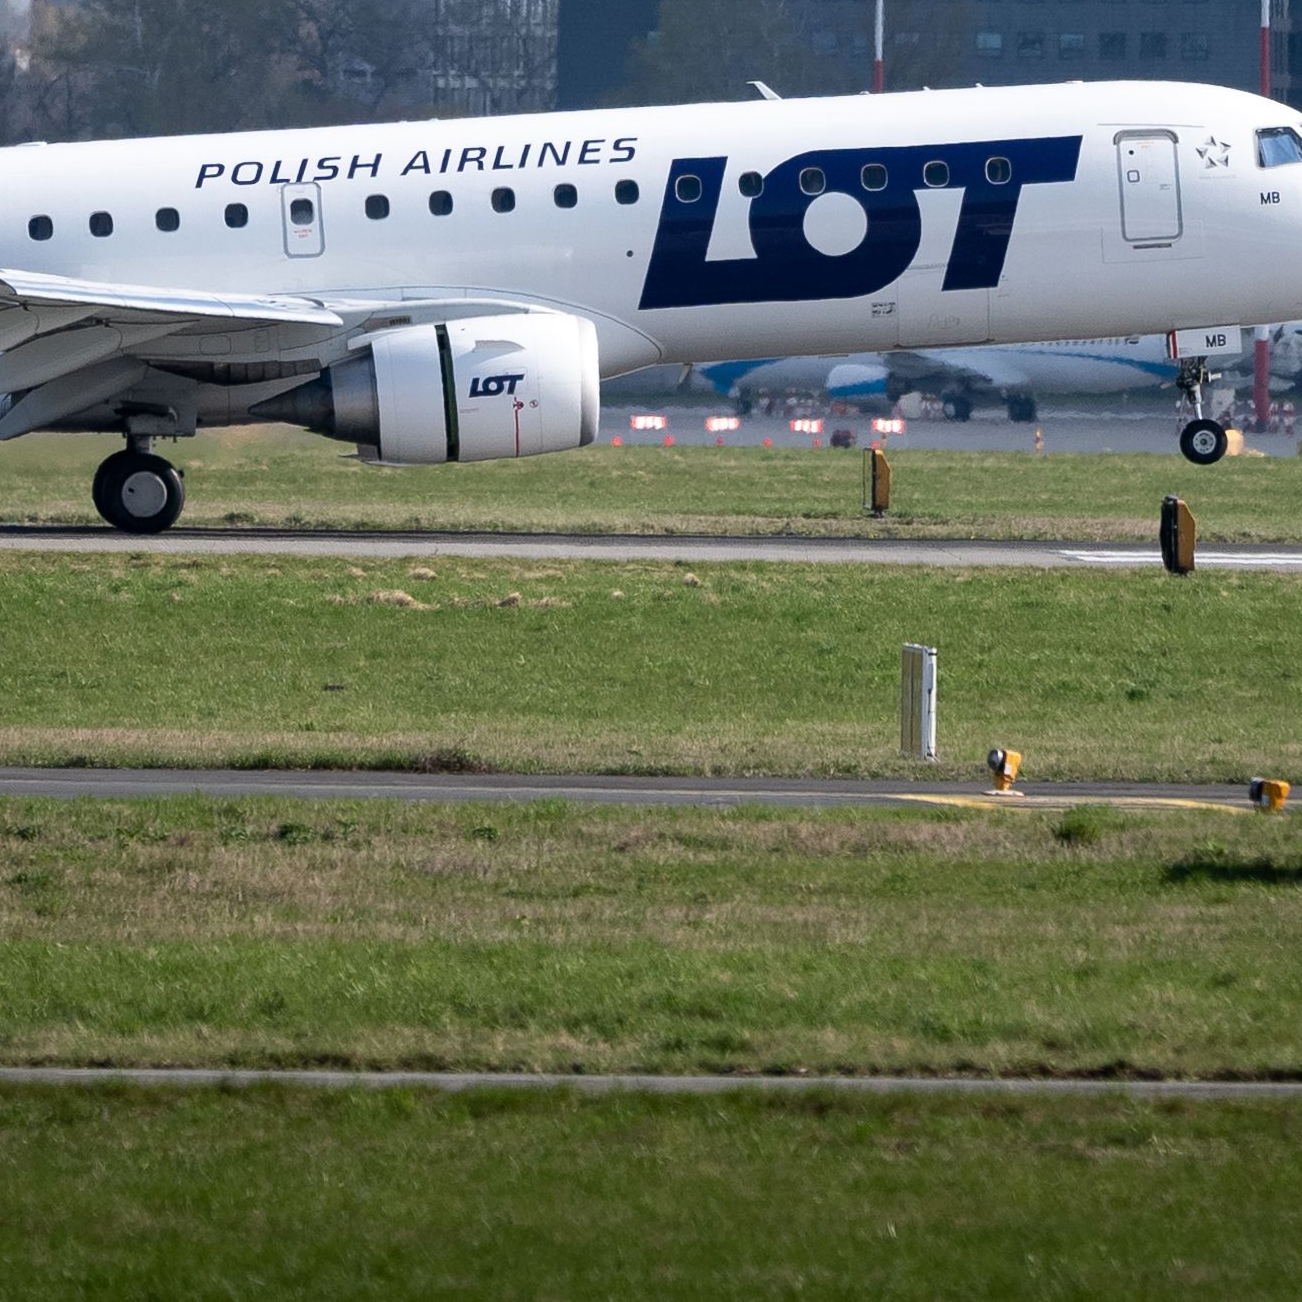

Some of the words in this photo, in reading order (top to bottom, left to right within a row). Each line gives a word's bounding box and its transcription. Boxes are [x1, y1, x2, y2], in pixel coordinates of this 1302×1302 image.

[195, 153, 383, 189] POLISH
[401, 137, 638, 176] AIRLINES
[1260, 192, 1280, 205] MB
[638, 135, 1083, 310] LOT
[1205, 334, 1227, 348] MB
[469, 374, 525, 398] LOT
